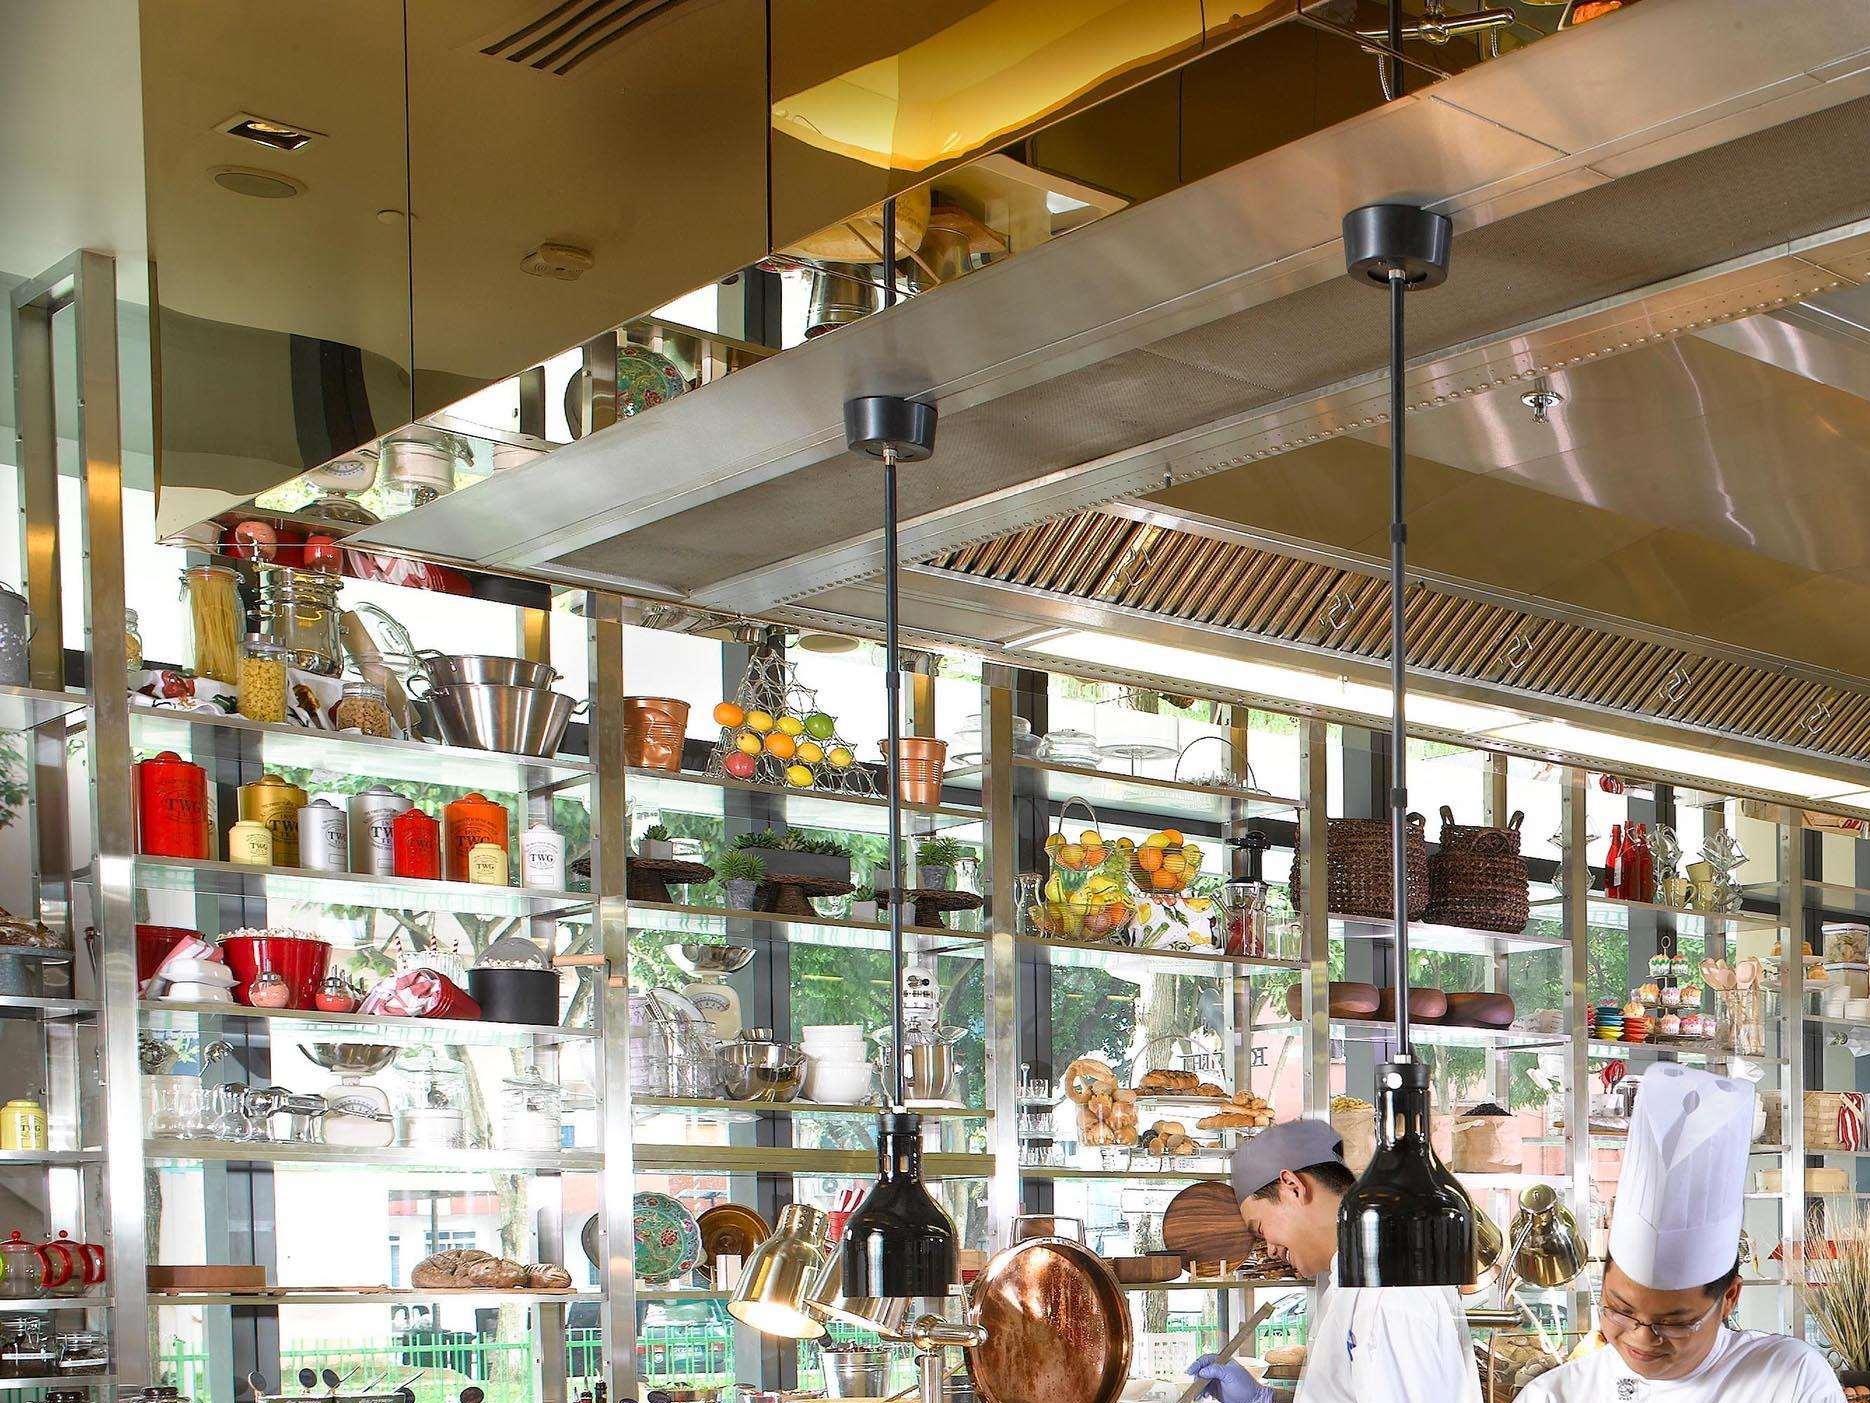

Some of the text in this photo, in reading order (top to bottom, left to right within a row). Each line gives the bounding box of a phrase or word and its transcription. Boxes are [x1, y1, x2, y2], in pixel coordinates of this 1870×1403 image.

[166, 797, 201, 812] TWG
[372, 826, 394, 839] TW
[249, 842, 268, 851] TWG
[530, 853, 554, 863] TWG
[476, 862, 495, 870] TWG
